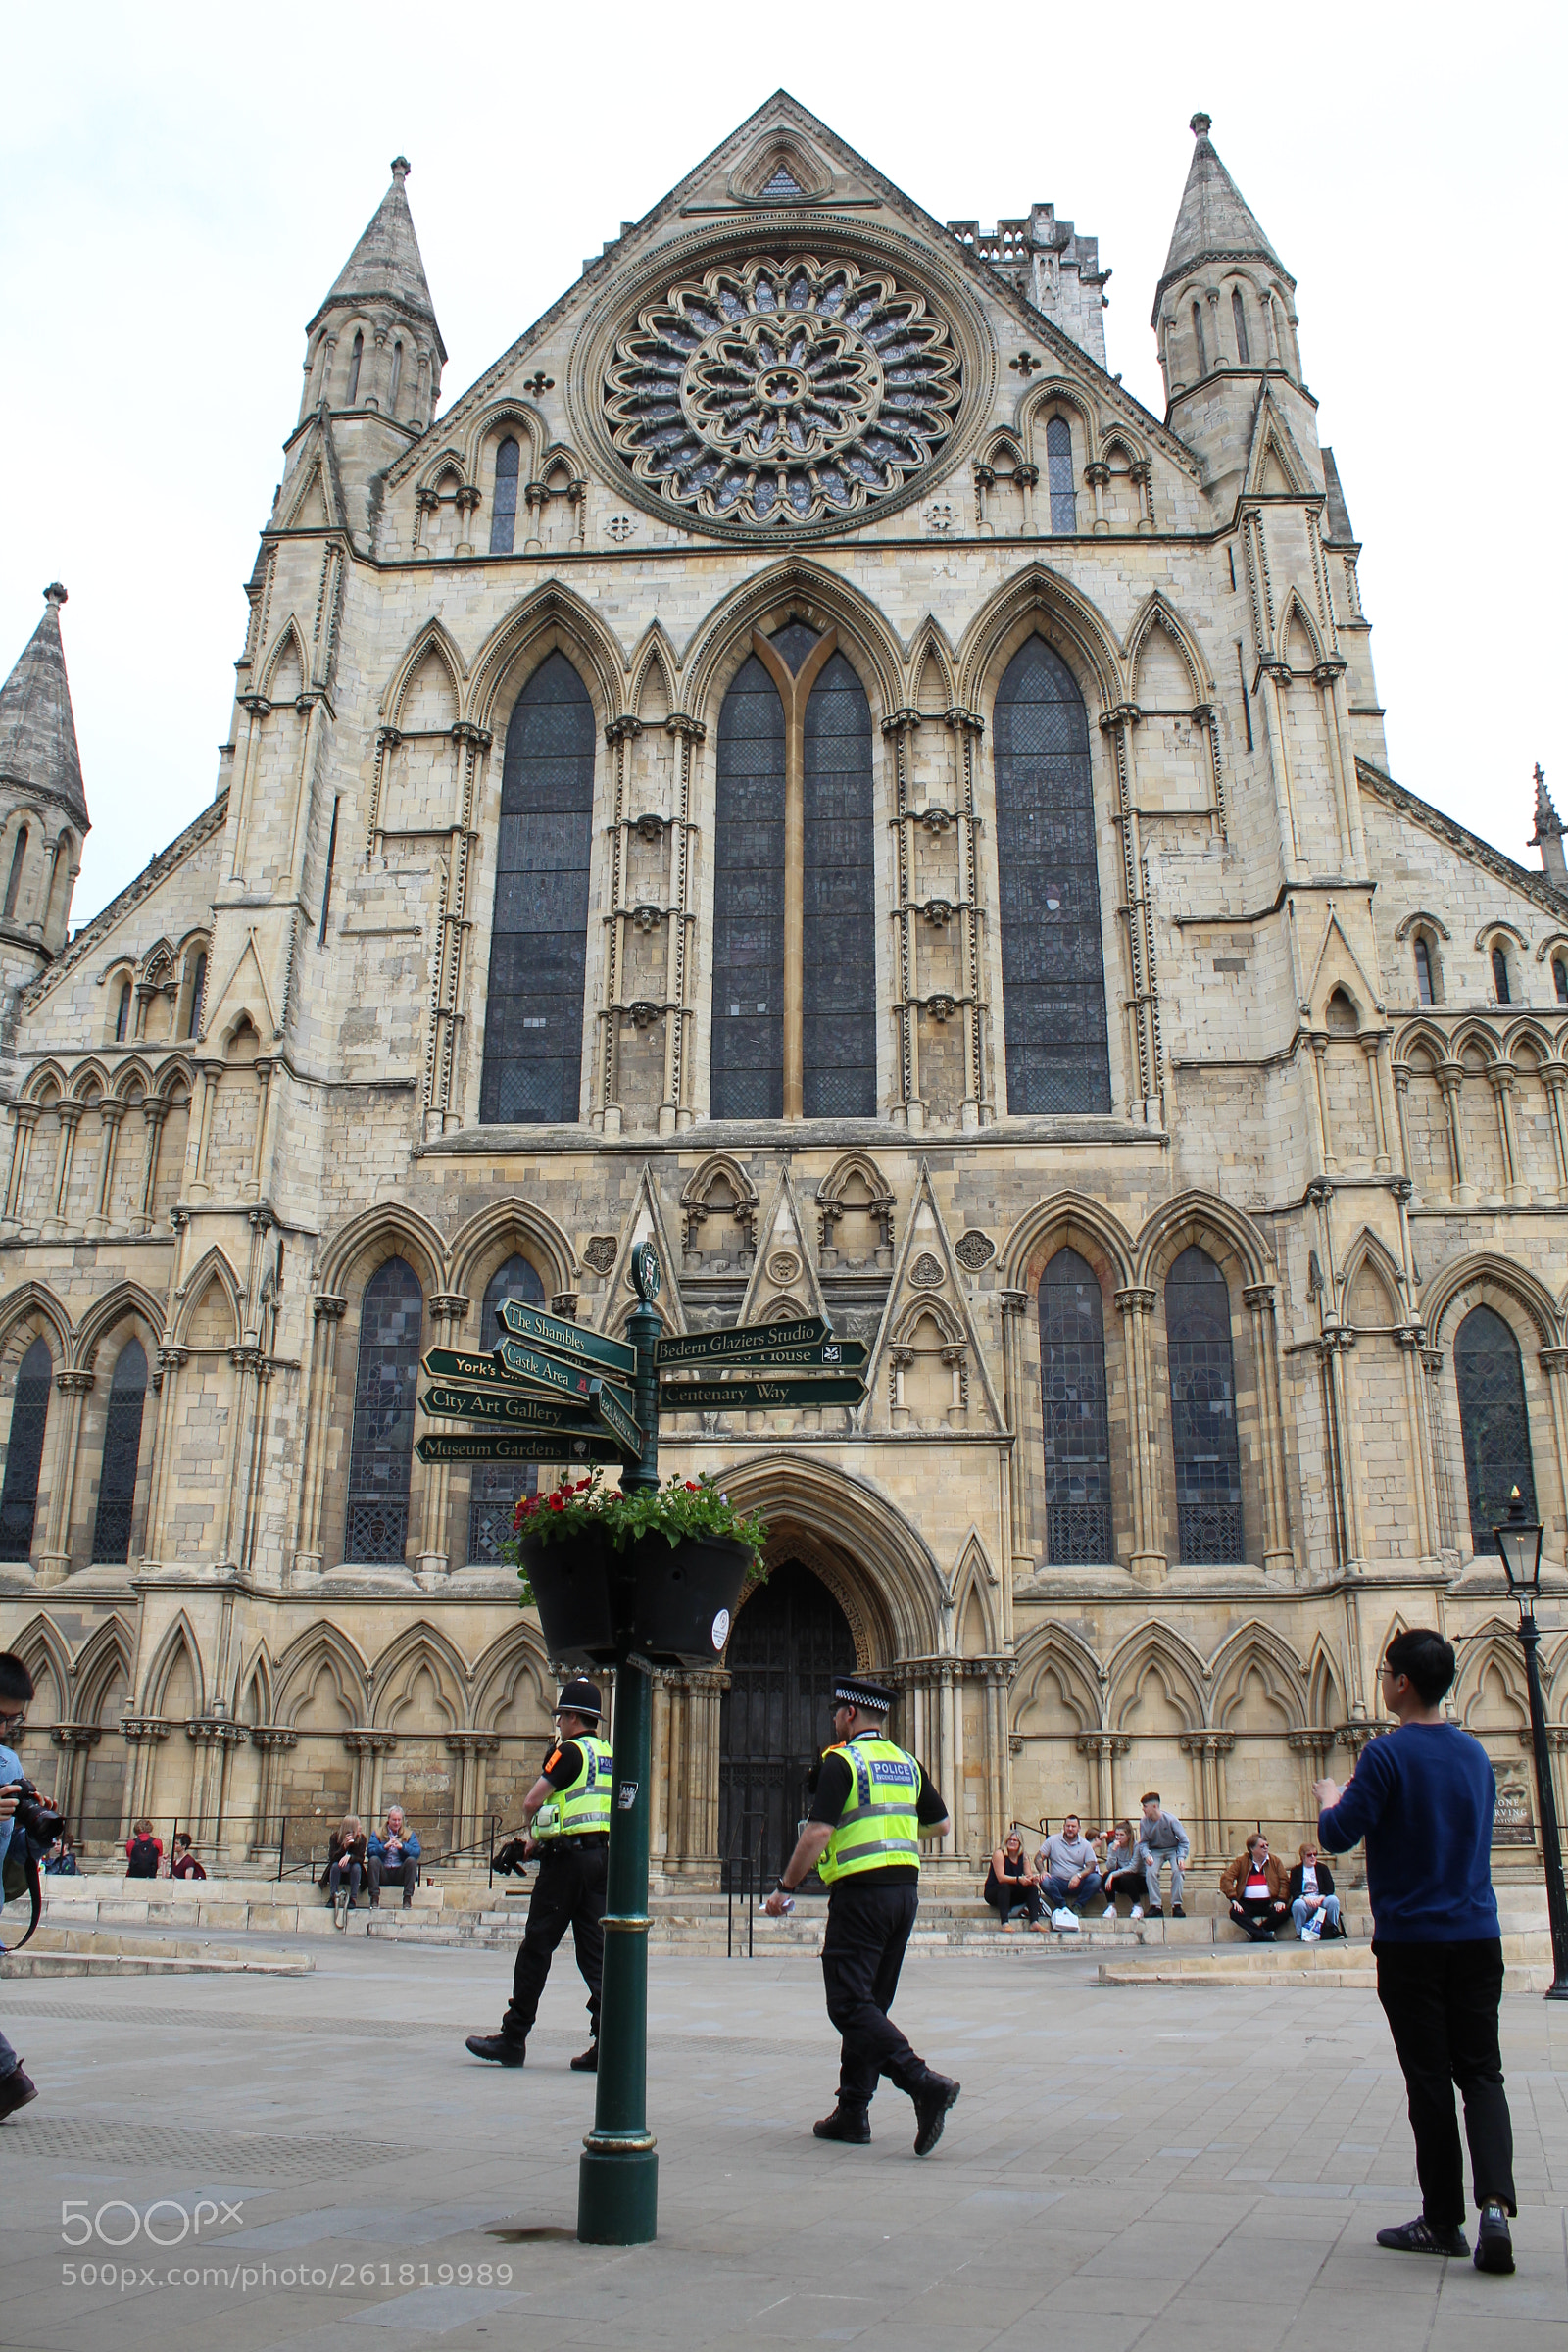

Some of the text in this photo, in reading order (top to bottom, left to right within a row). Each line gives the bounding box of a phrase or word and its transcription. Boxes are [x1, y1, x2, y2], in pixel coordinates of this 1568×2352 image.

[509, 1307, 585, 1350] The Shambles
[659, 1341, 707, 1359] Bedern
[710, 1333, 764, 1351] Glaziers
[767, 1324, 814, 1344] Studio
[456, 1358, 496, 1377] York's
[506, 1348, 539, 1373] Castle
[542, 1362, 569, 1386] Area
[665, 1383, 790, 1404] Centenary Way
[432, 1389, 563, 1427] City Art Gallery
[424, 1440, 562, 1457] Museum Gardens
[873, 1763, 910, 1775] POLICE
[1494, 1808, 1528, 1817] RVING
